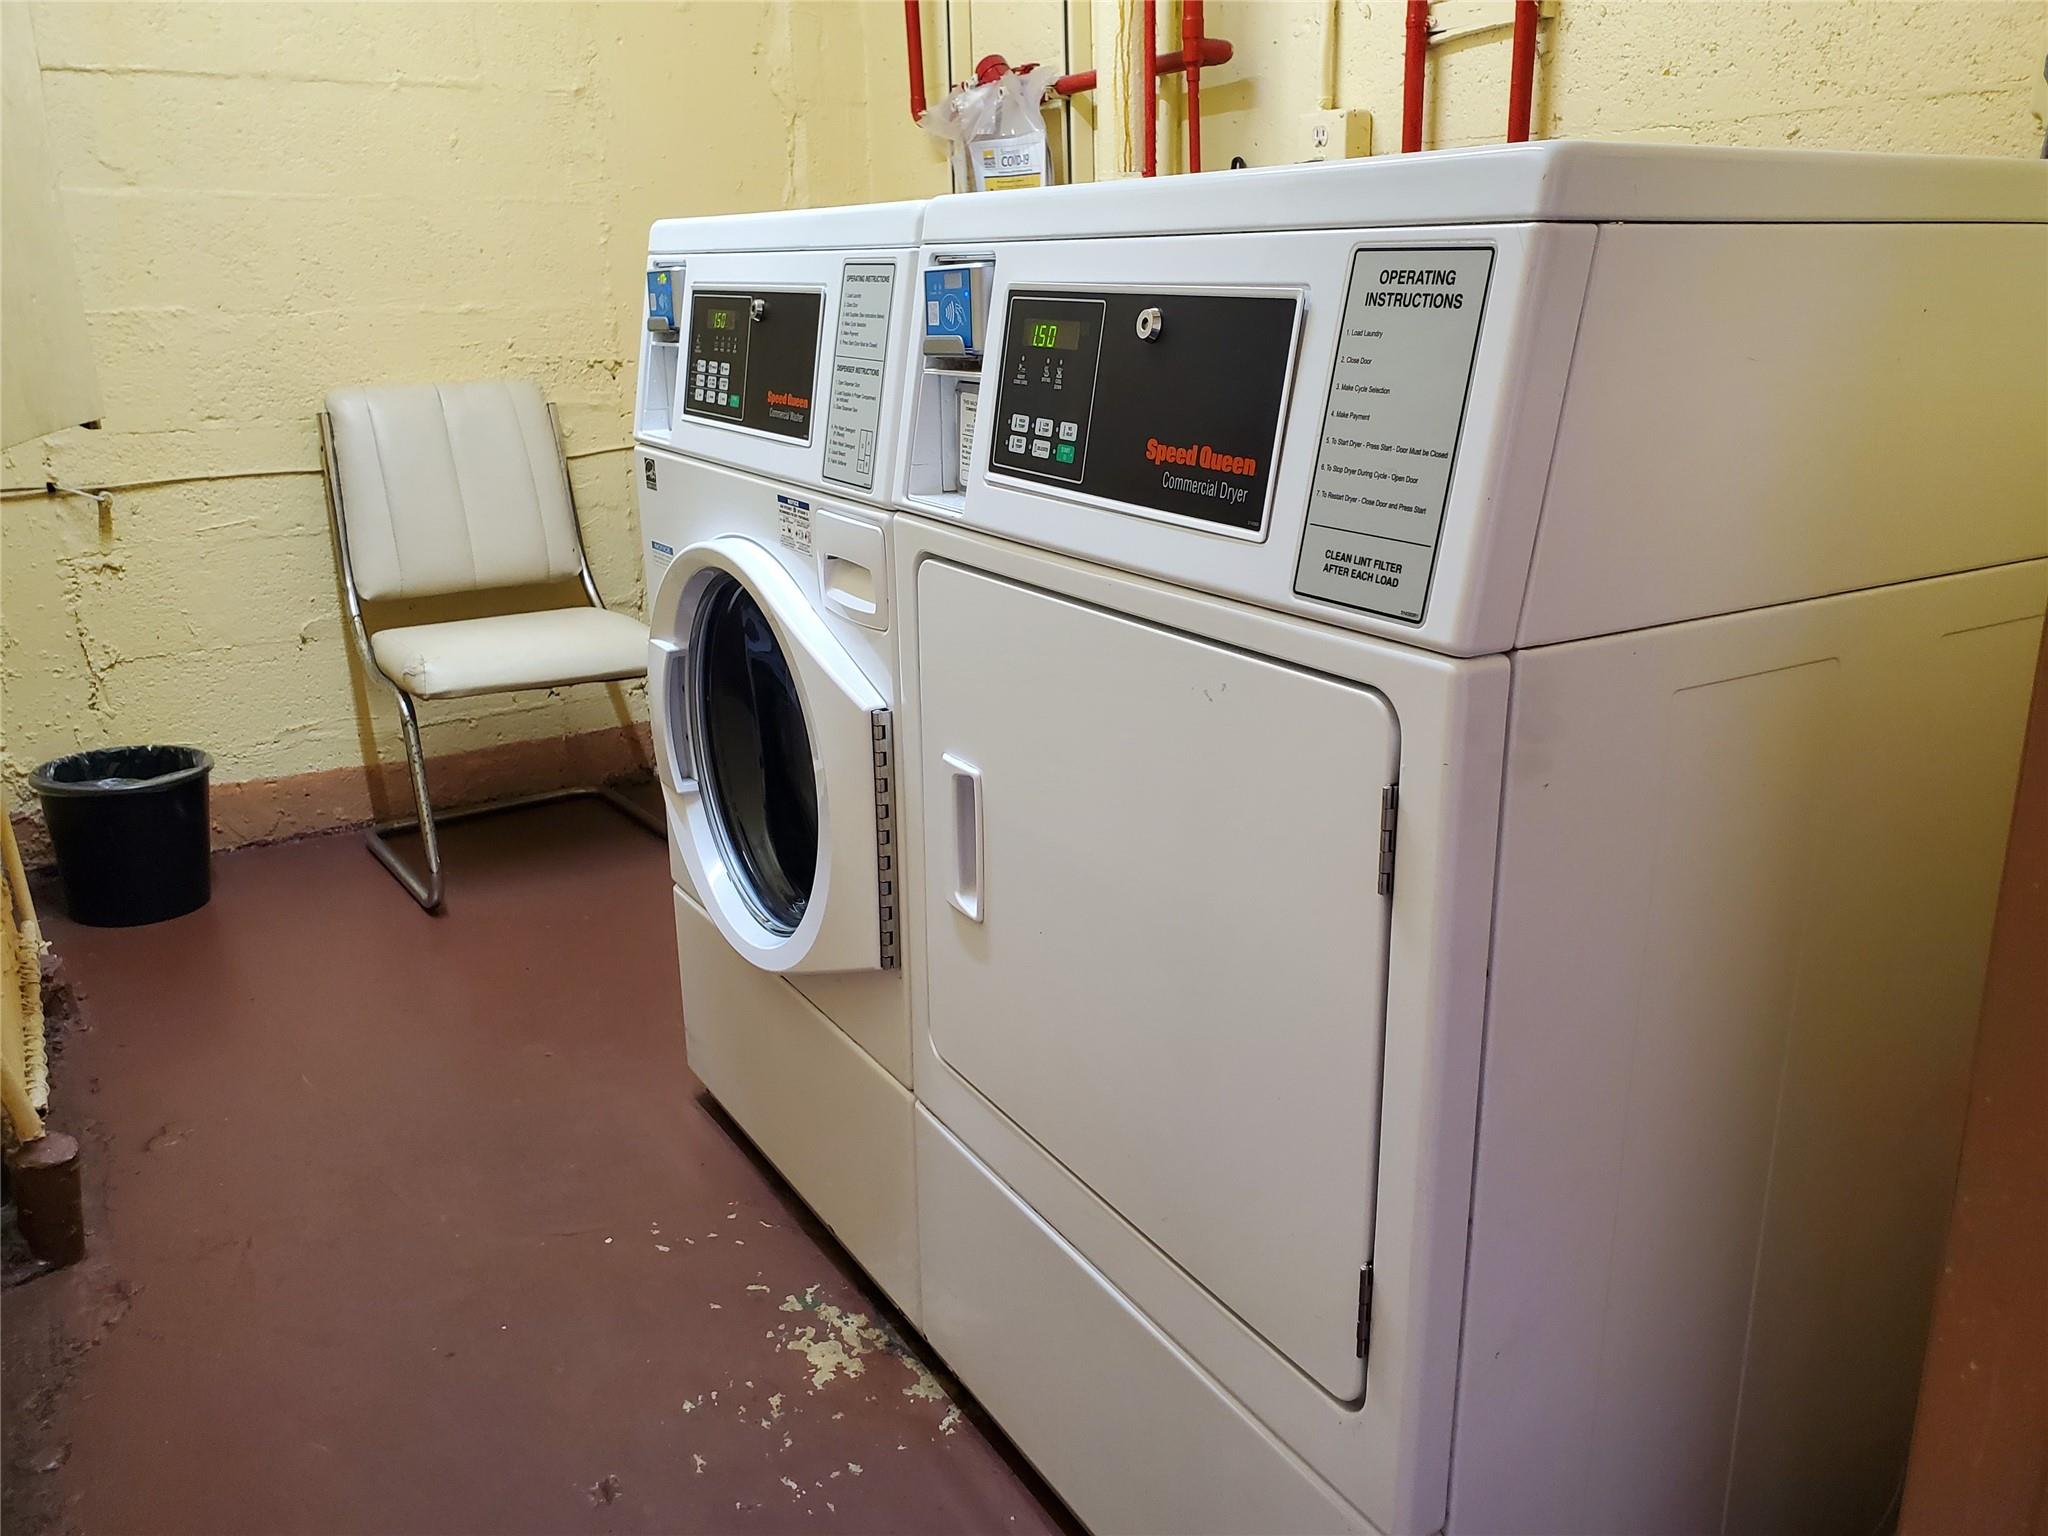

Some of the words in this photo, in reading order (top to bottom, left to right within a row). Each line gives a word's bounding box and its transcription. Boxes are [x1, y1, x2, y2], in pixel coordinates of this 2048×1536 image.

[1379, 269, 1457, 286] OPERATING
[1364, 292, 1464, 309] INSTRUCTIONS
[1352, 329, 1364, 337] Load
[1364, 330, 1384, 339] Laundry
[1347, 356, 1360, 364] Close
[1360, 357, 1373, 365] Door
[1341, 383, 1354, 391] Make
[1354, 384, 1368, 394] Cycle
[1368, 385, 1391, 395] Selection
[767, 390, 787, 406] Speed
[788, 393, 809, 409] Queen
[1335, 410, 1349, 419] Make
[1349, 411, 1371, 421] Payment
[1145, 438, 1199, 466] Speed
[1199, 445, 1257, 477] Queen
[1331, 437, 1337, 445] To
[1338, 438, 1349, 447] Start
[1349, 440, 1363, 449] Dryer
[1366, 441, 1380, 450] Press
[1380, 443, 1392, 452] Start
[1396, 445, 1408, 454] Door
[1409, 447, 1422, 456] Must
[1422, 449, 1429, 457] be
[1430, 449, 1449, 459] Closed
[1326, 464, 1332, 472] To
[1332, 465, 1344, 474] Stop
[1344, 466, 1357, 476] Dryer
[1357, 468, 1373, 479] During
[1373, 471, 1388, 480] Cycle
[1391, 473, 1405, 483] Open
[1405, 475, 1419, 484] Door
[1162, 471, 1218, 497] Commercial
[1219, 481, 1249, 505] Dryer
[1321, 490, 1327, 498] To
[1327, 491, 1344, 502] Restart
[1344, 494, 1358, 504] Dryer
[1361, 497, 1375, 506] Close
[1375, 499, 1388, 508] Door
[1398, 503, 1413, 513] Press
[1414, 505, 1427, 515] Start
[1325, 549, 1353, 564] CLEAN
[1353, 555, 1373, 568] LINT
[1373, 559, 1403, 574] FILTER
[1322, 563, 1350, 577] AFTER
[1350, 568, 1375, 582] EACH
[1375, 574, 1400, 588] LOAD
